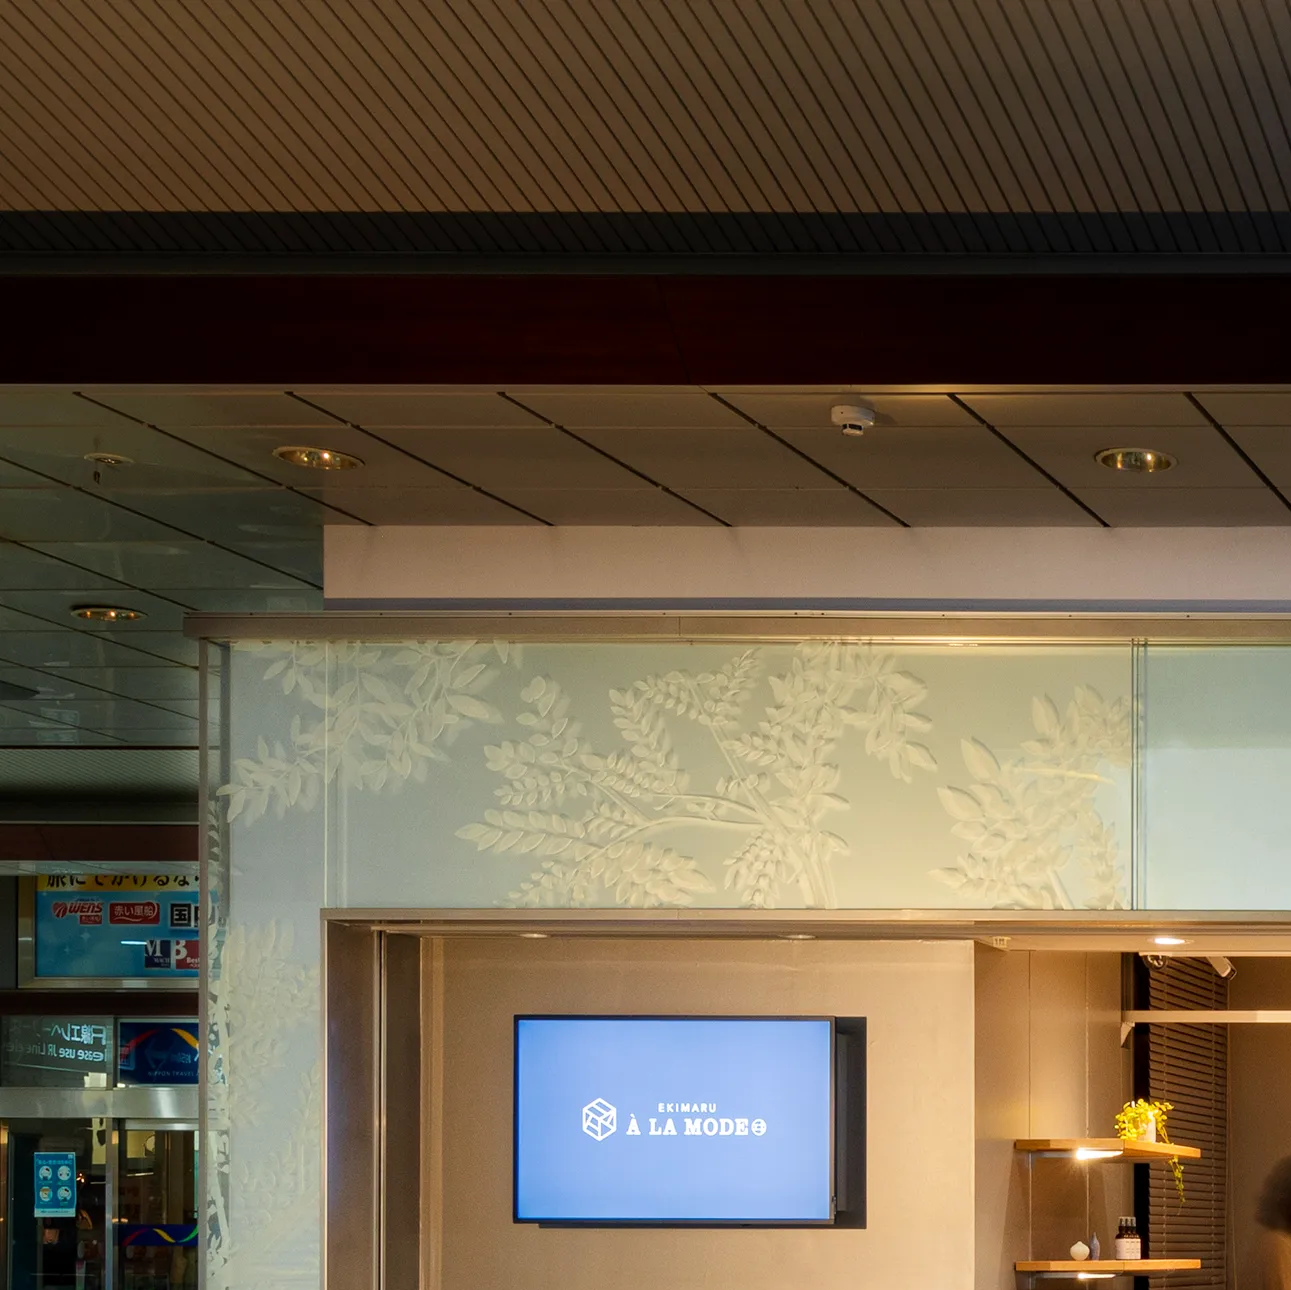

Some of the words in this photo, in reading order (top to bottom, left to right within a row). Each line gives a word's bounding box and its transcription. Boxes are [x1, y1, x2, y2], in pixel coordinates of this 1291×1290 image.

[47, 875, 199, 887] 旅にでかけるな
[113, 905, 154, 917] 赤い風船
[658, 1103, 717, 1113] EKIMARU
[626, 1114, 641, 1136] À
[649, 1118, 677, 1136] LA
[684, 1118, 749, 1136] MODE
